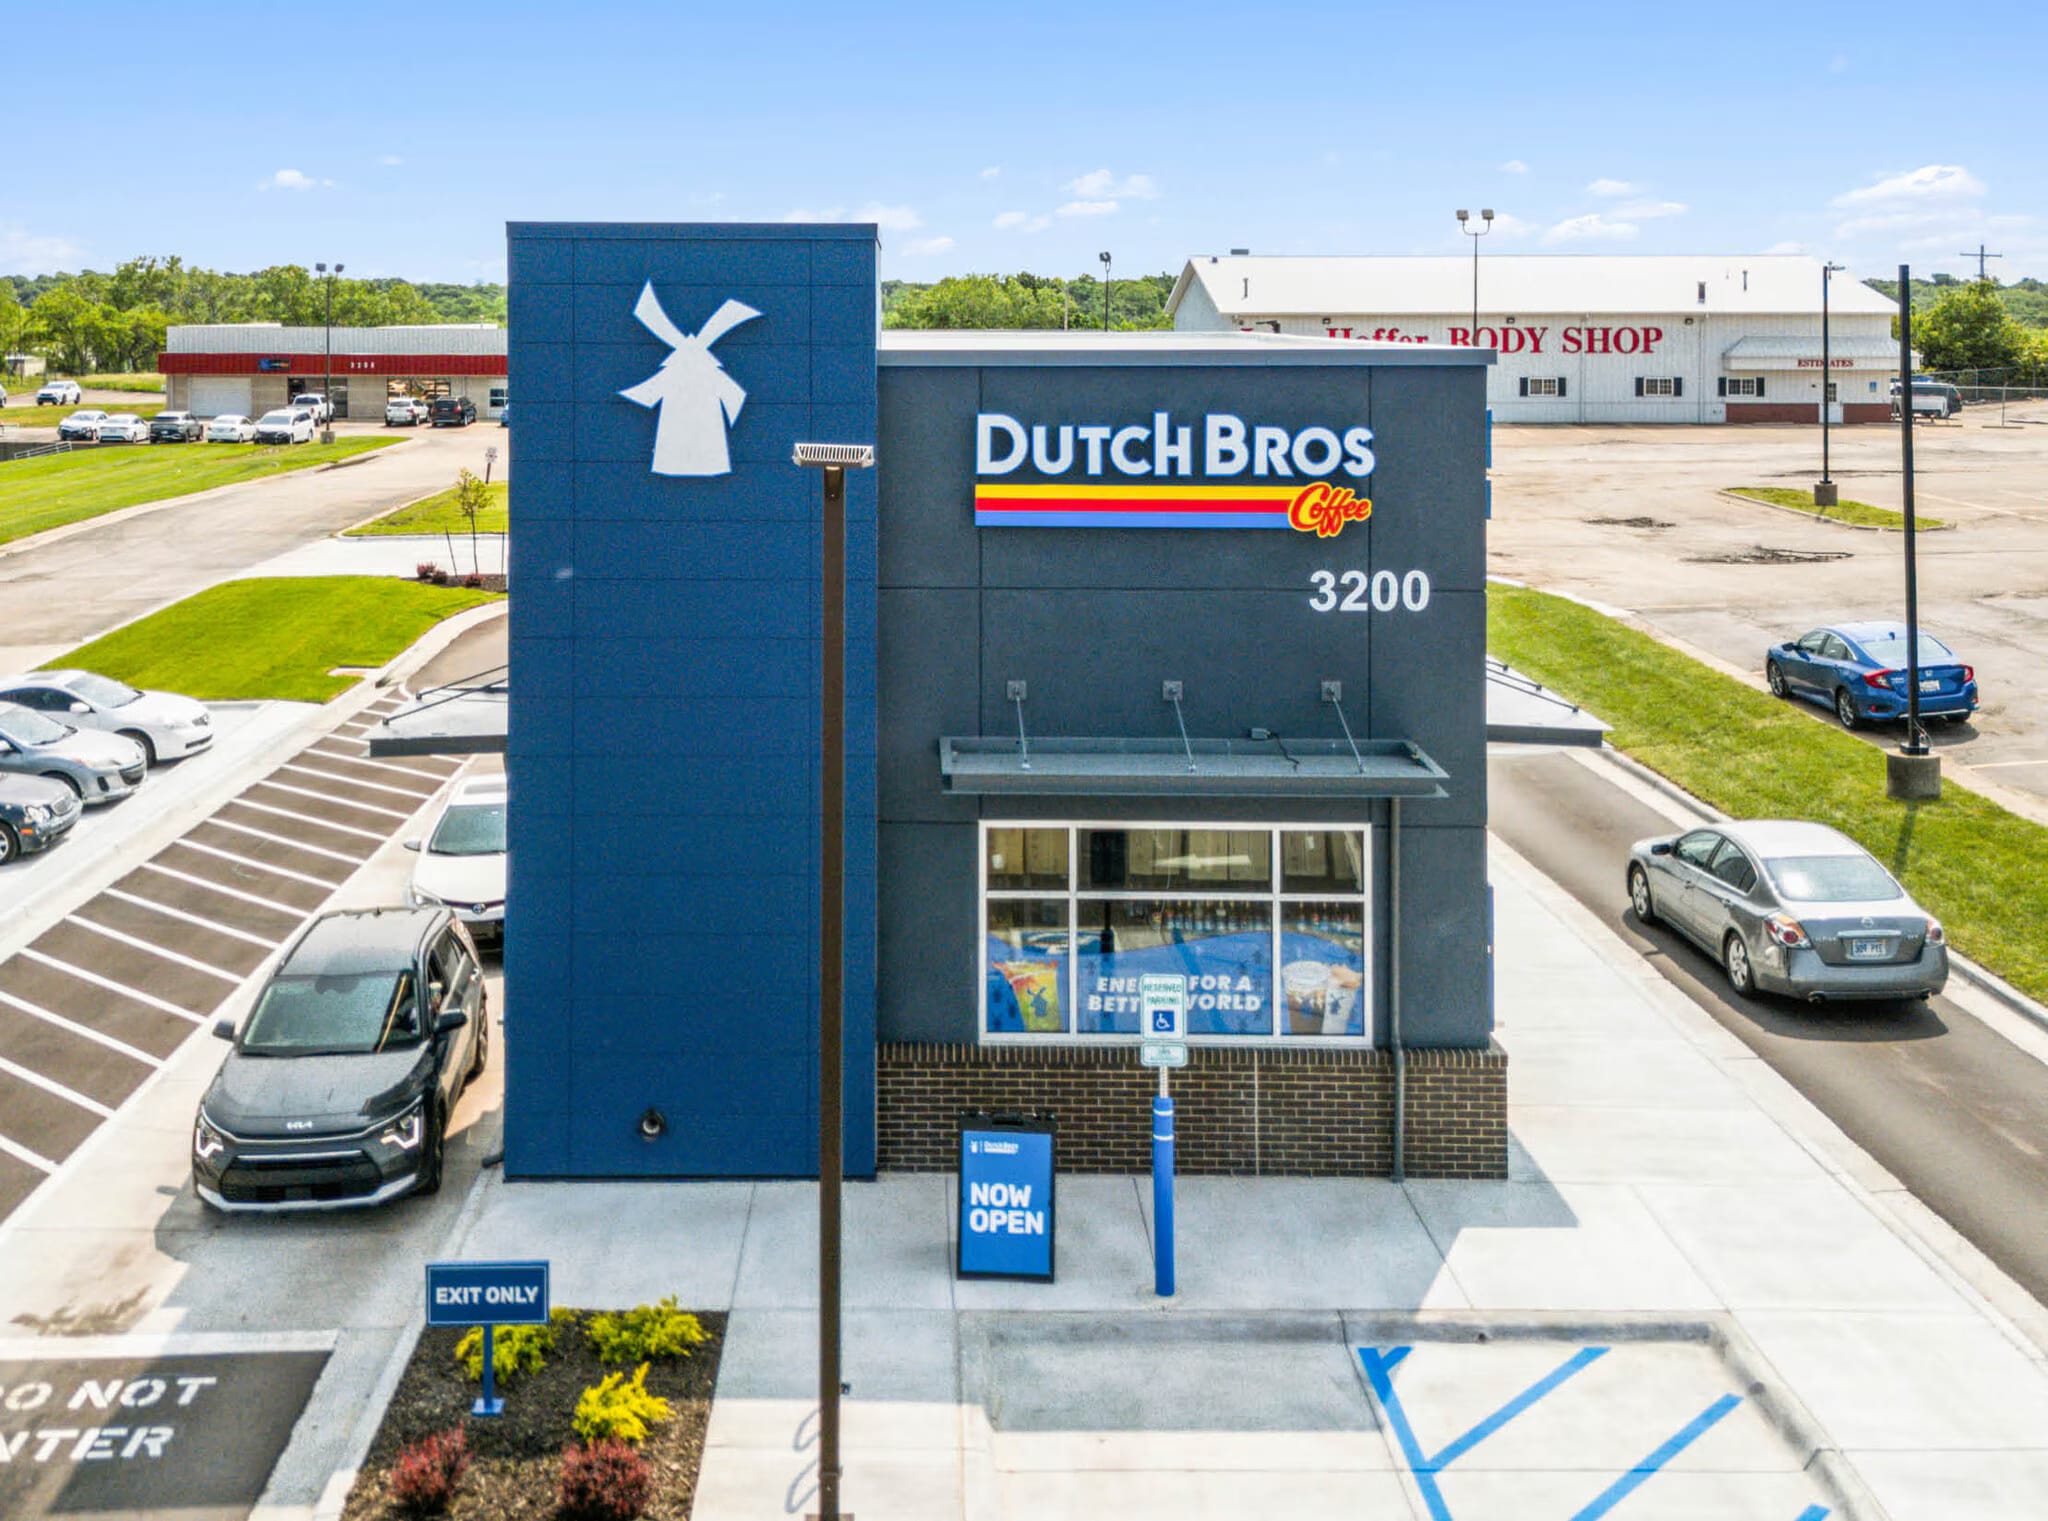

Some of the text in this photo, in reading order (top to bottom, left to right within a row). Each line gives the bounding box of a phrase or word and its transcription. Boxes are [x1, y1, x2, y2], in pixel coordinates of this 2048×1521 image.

[1448, 326, 1548, 354] BODY
[1562, 326, 1663, 354] SHOP
[975, 411, 1376, 477] DUTCH BROS
[1288, 482, 1371, 538] Coffee
[1308, 570, 1430, 612] 3200
[1097, 975, 1252, 993] ENE FOR A
[1088, 994, 1141, 1013] BETT
[970, 1182, 1031, 1208] NOW
[969, 1208, 1044, 1234] OPEN
[436, 1286, 539, 1304] EXIT ONLY
[0, 1376, 217, 1411] O NOT
